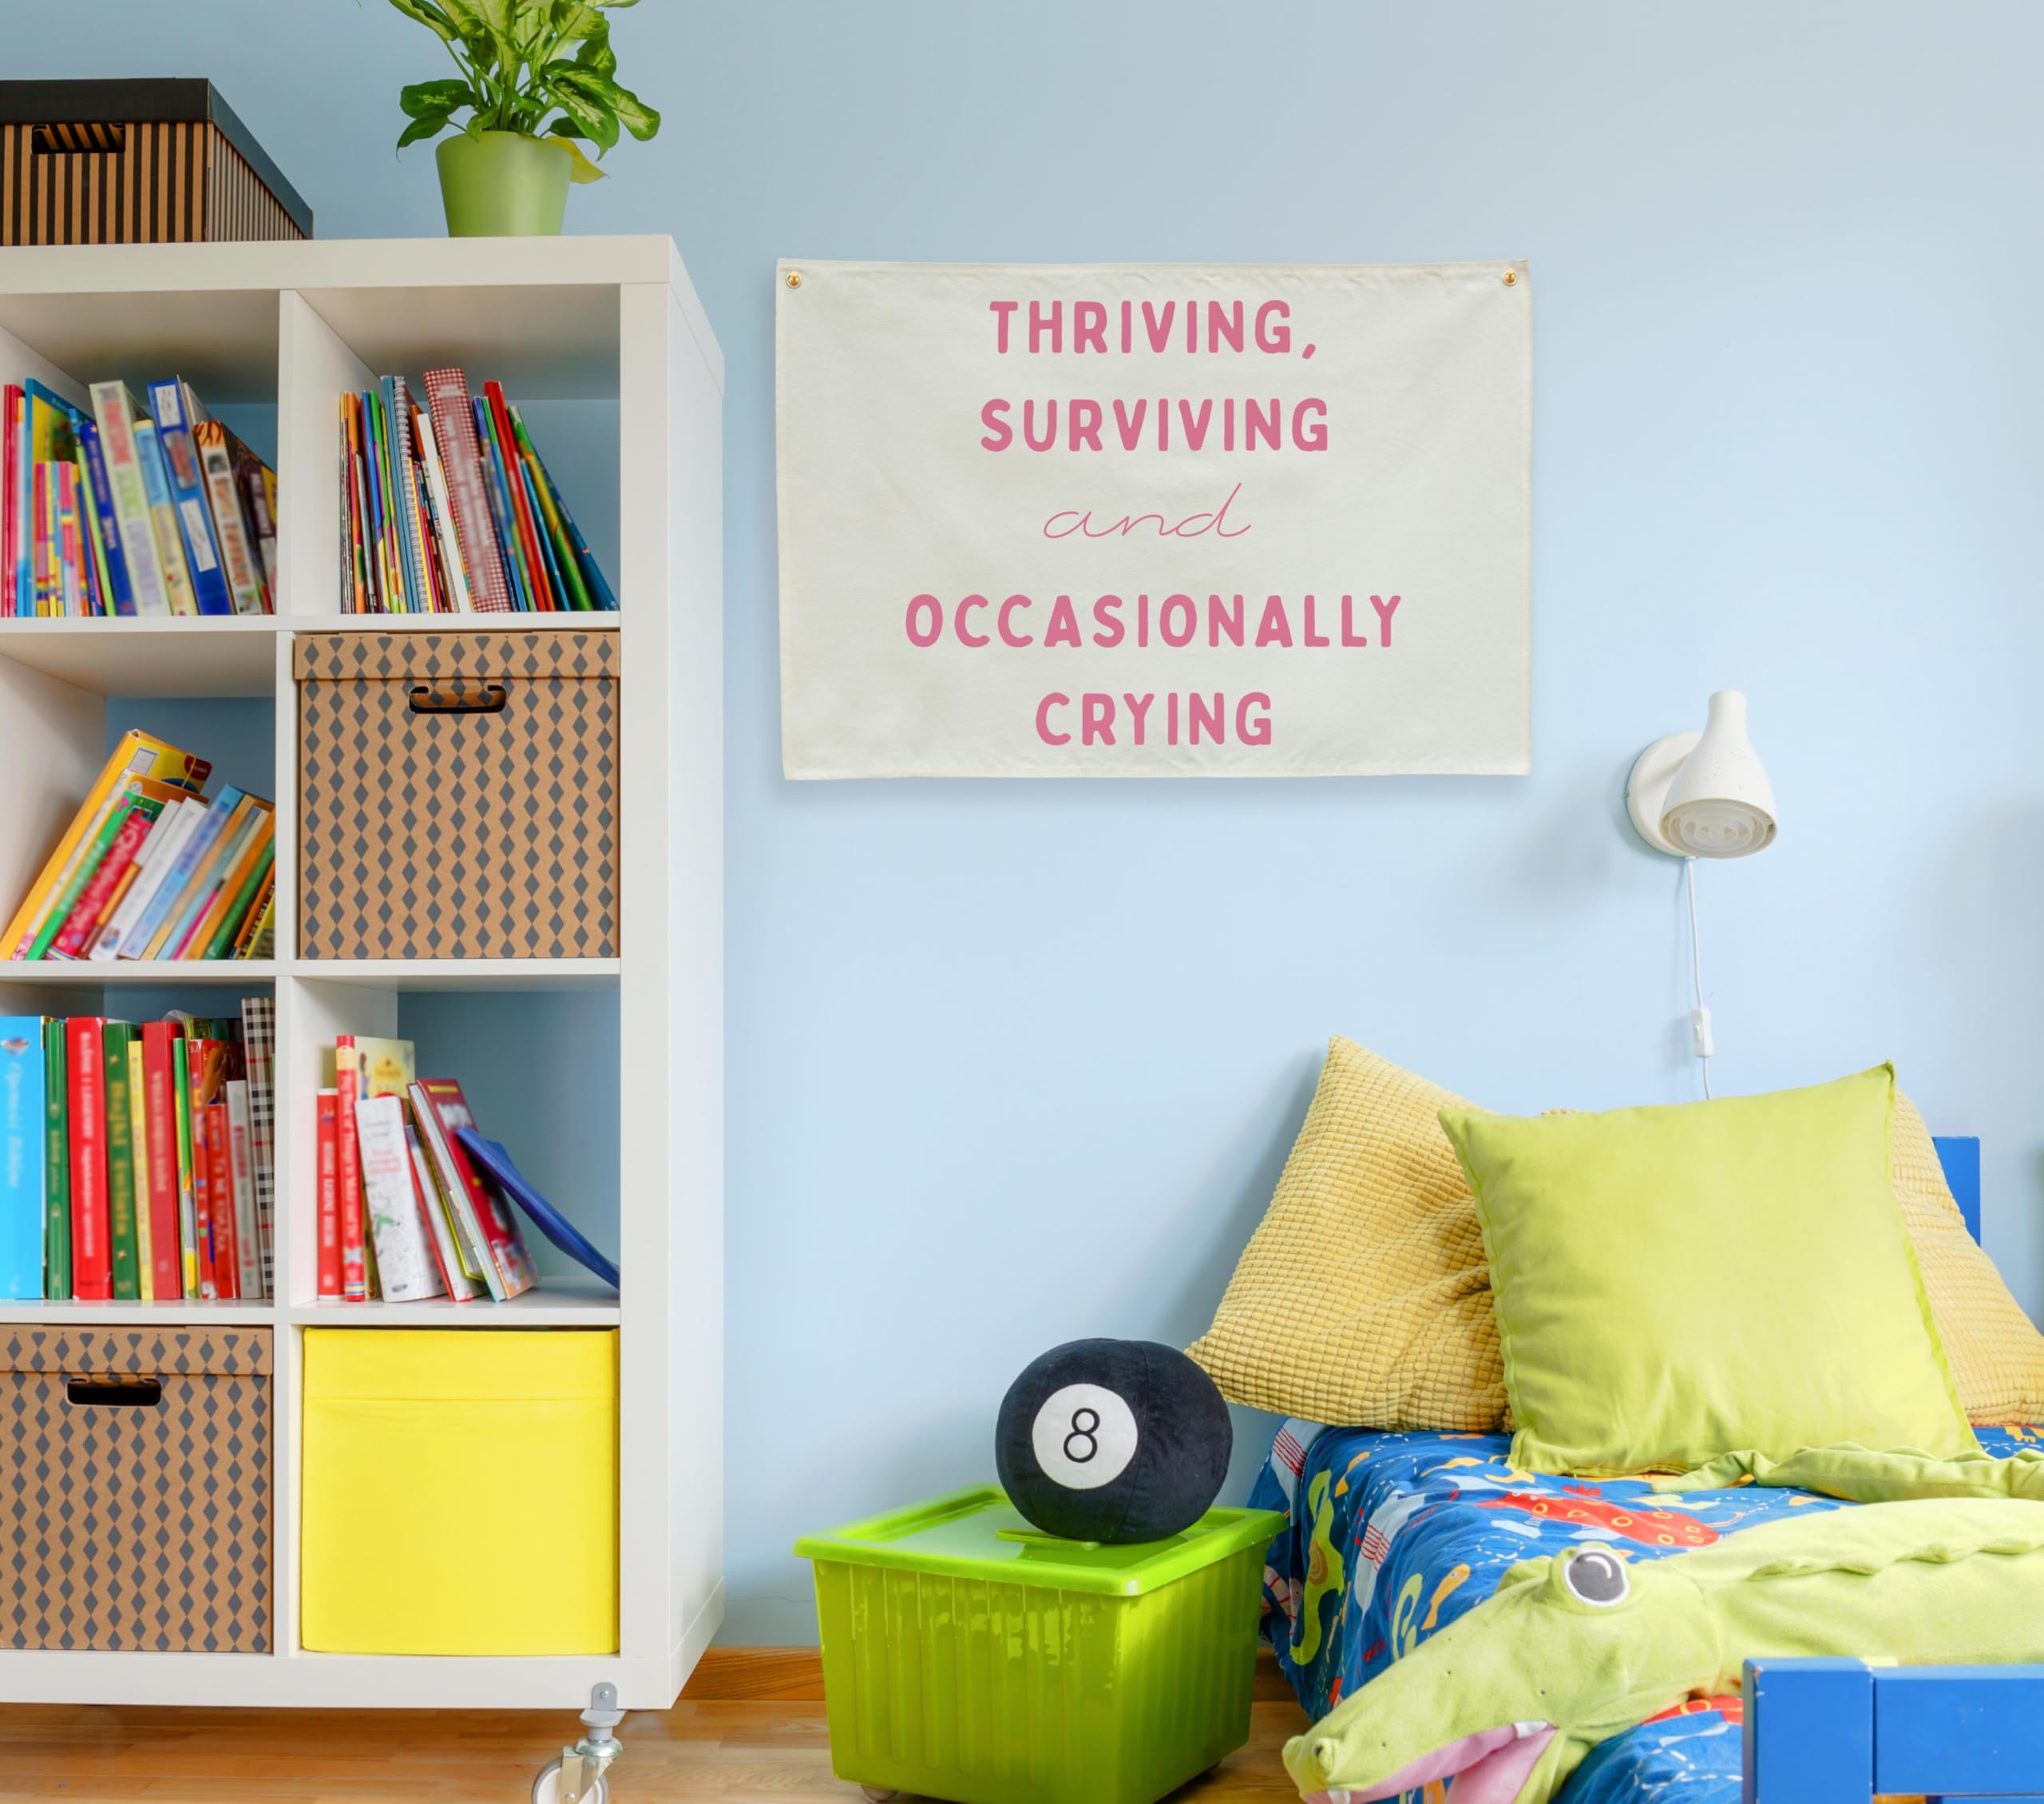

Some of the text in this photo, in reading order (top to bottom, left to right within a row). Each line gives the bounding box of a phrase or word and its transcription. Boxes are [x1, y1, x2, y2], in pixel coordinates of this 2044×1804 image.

[988, 299, 1317, 360] THRIVING,
[980, 398, 1329, 453] SURVIVING
[1043, 482, 1252, 539] and
[905, 593, 1402, 648] OCCASIONALLY
[1035, 692, 1273, 747] CRYING
[1063, 1407, 1100, 1463] 8
